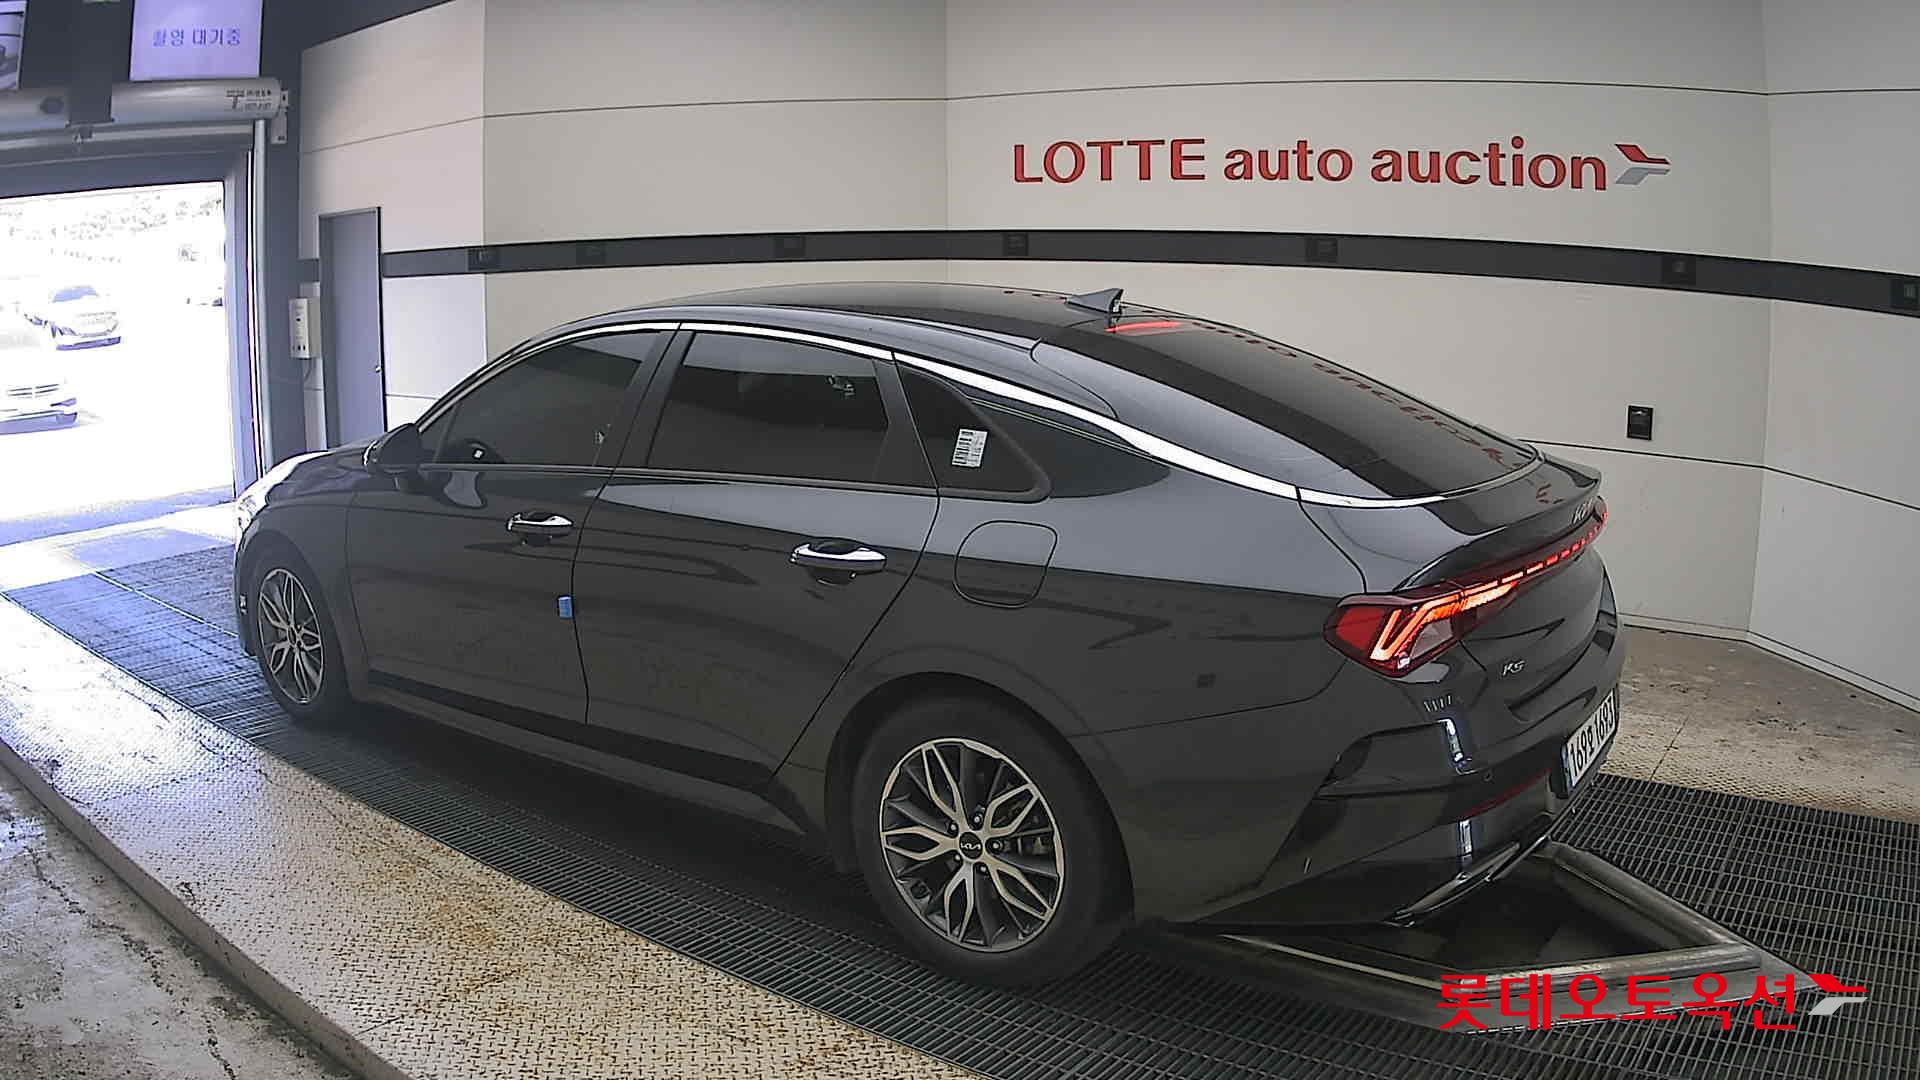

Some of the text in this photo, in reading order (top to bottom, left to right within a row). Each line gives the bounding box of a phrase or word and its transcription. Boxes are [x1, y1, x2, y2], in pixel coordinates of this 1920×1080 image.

[192, 28, 241, 46] 대기중
[1013, 135, 1607, 191] LOTTE auto auction
[1502, 660, 1525, 676] K5
